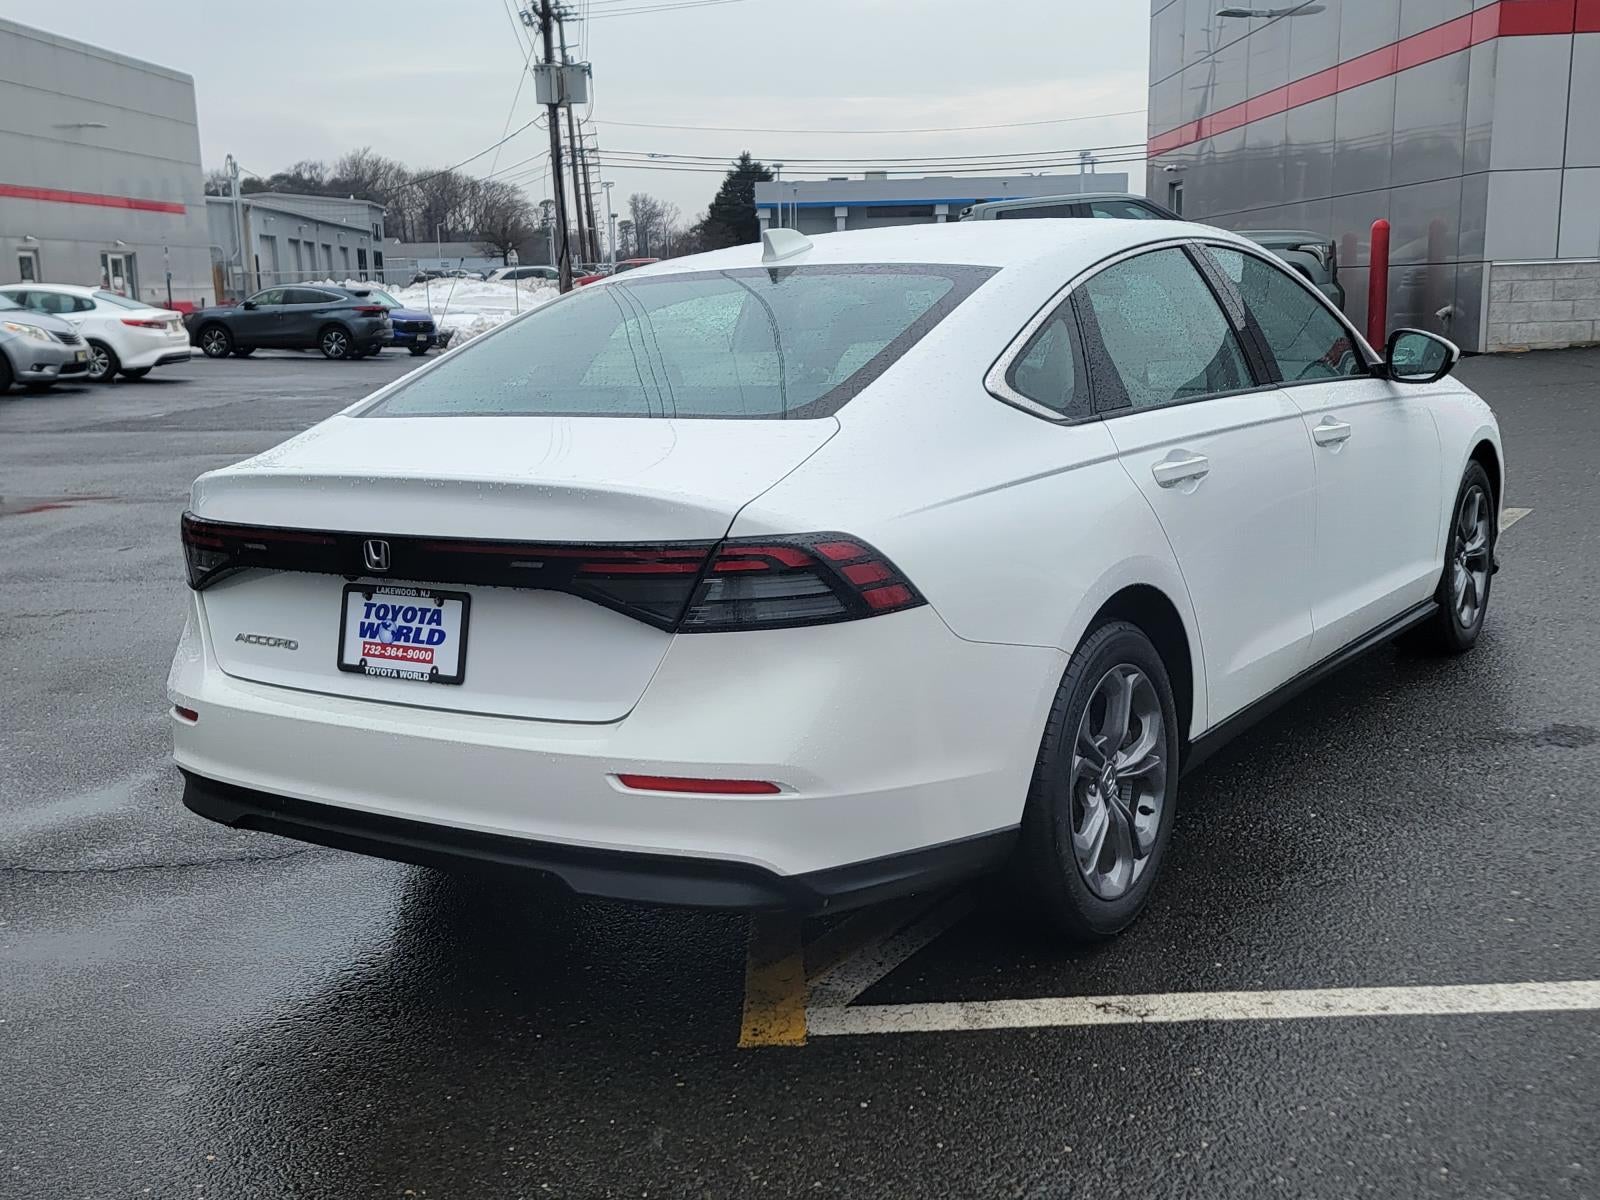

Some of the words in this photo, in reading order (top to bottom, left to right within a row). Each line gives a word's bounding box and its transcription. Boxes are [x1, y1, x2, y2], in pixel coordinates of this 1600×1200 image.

[363, 602, 442, 626] TOYOTA
[235, 633, 299, 650] ACCORD
[363, 644, 432, 660] 732-364-9000
[364, 666, 398, 678] TOYOTA
[399, 670, 430, 681] WORLD
